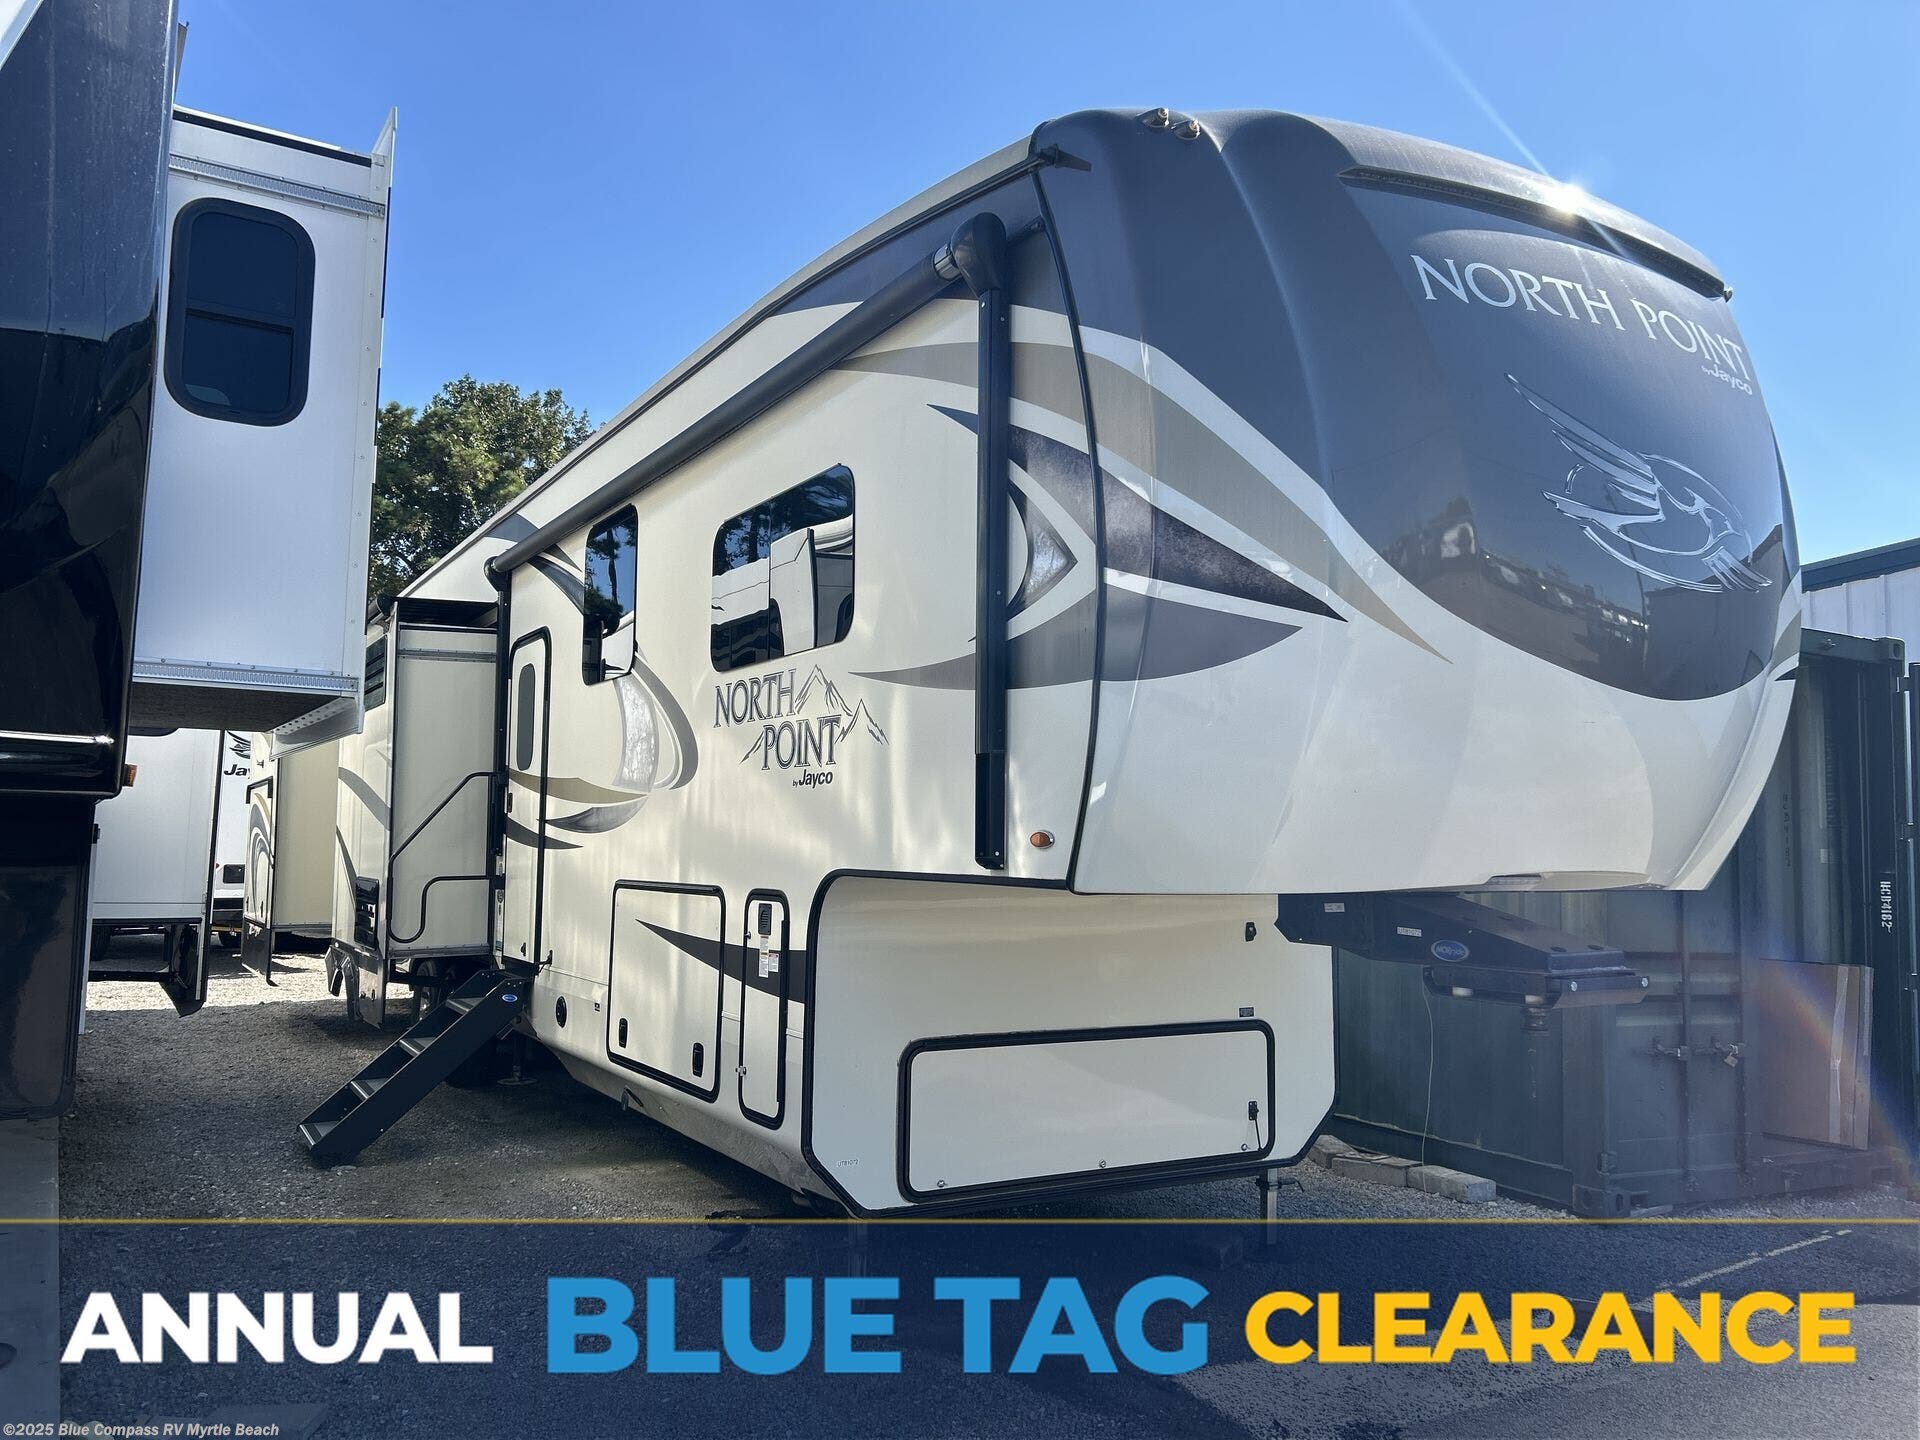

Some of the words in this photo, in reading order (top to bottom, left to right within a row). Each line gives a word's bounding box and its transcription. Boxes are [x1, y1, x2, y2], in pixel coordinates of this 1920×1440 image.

[1410, 254, 1626, 331] NORTH
[1629, 298, 1750, 380] POINT
[1708, 363, 1753, 396] Jayco
[713, 668, 797, 728] NORTH
[761, 713, 842, 771] POINT
[798, 768, 834, 789] Jayco
